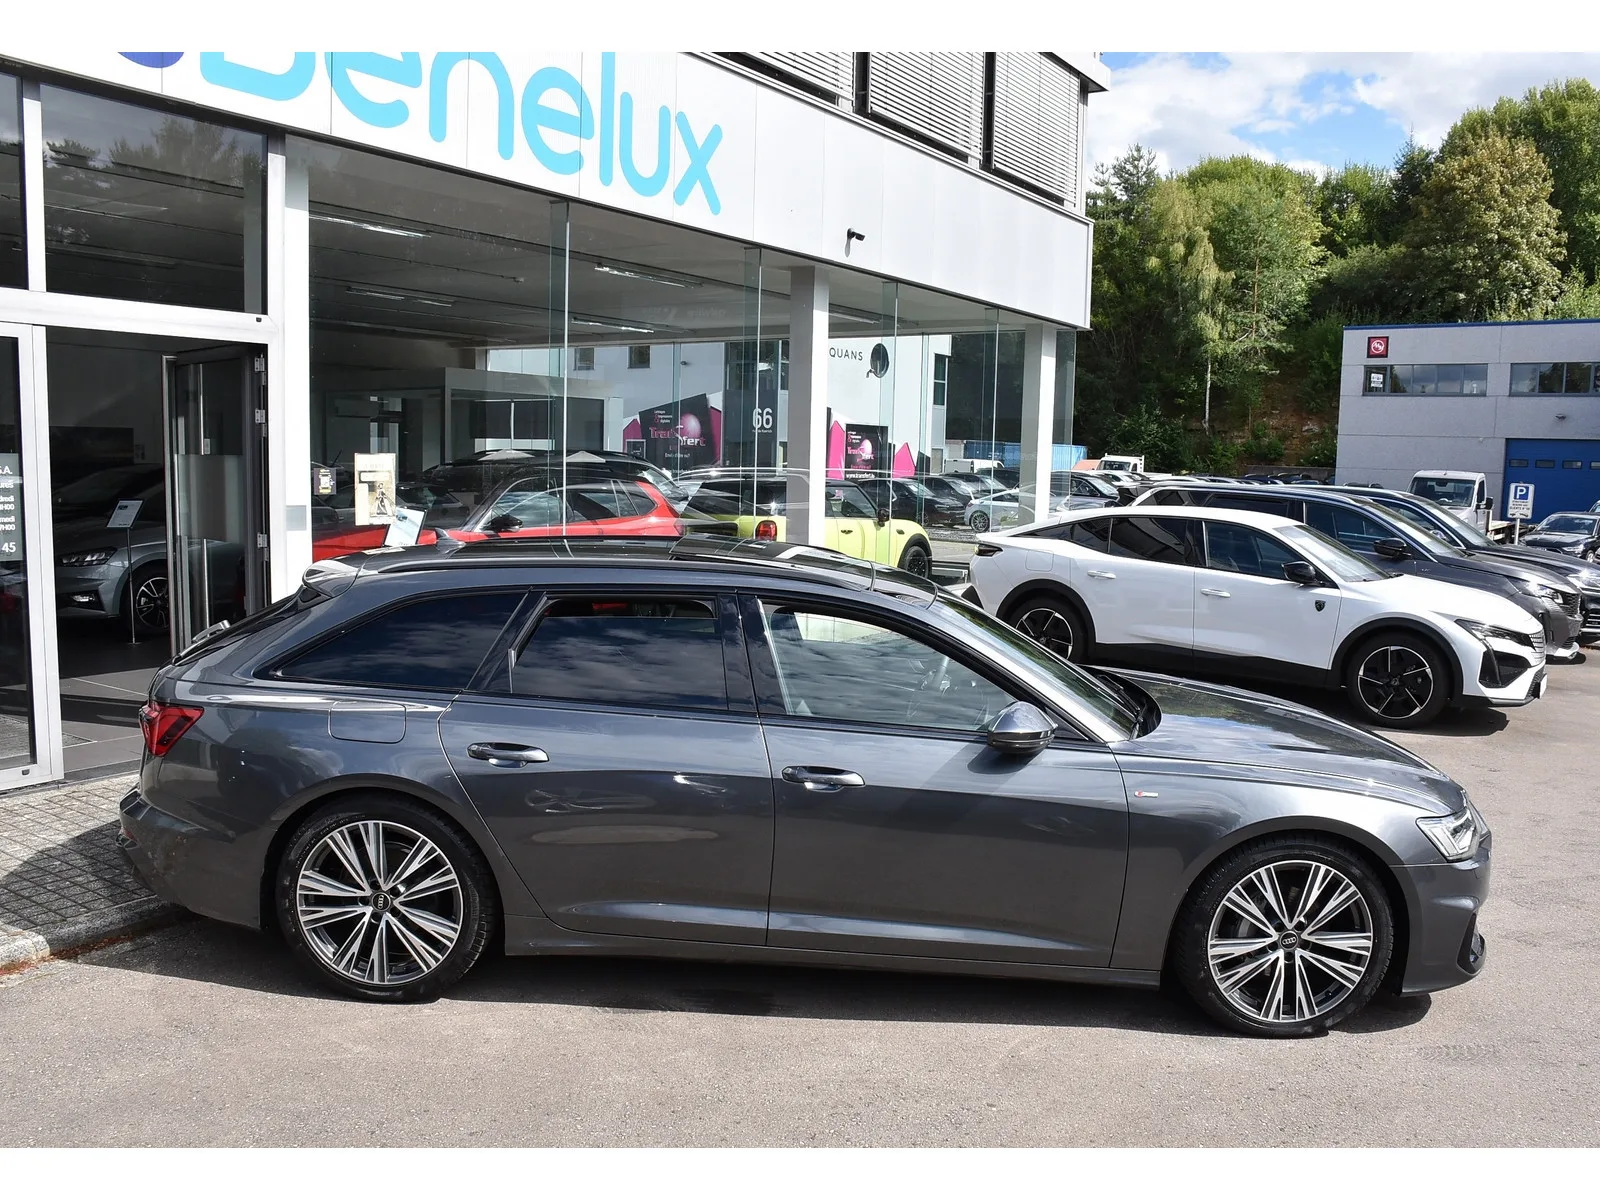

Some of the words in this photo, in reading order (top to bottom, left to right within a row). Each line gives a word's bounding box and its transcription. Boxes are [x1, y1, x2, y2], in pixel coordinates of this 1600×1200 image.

[752, 407, 773, 429] 66
[1516, 487, 1526, 499] P
[2, 542, 16, 552] 45
